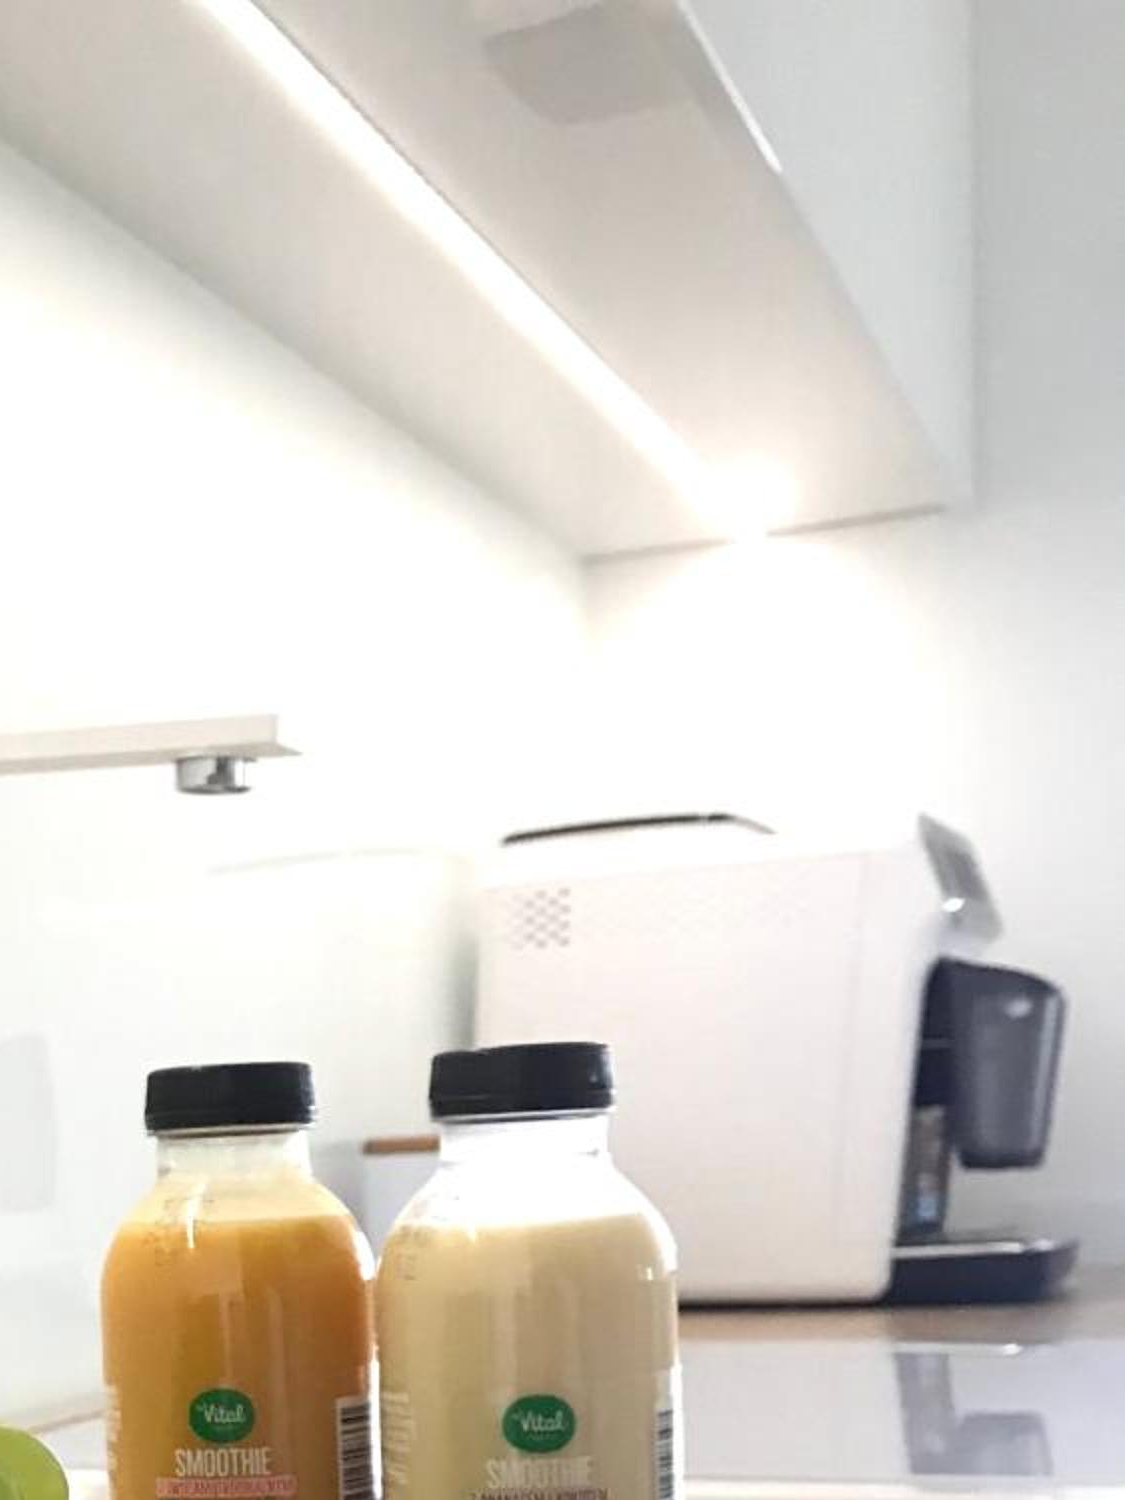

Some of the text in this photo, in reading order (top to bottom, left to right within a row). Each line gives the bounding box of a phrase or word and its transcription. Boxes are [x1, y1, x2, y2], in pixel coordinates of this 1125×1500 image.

[200, 1402, 246, 1423] Vital
[520, 1409, 564, 1432] Vital
[174, 1446, 272, 1477] SMOOTHIE
